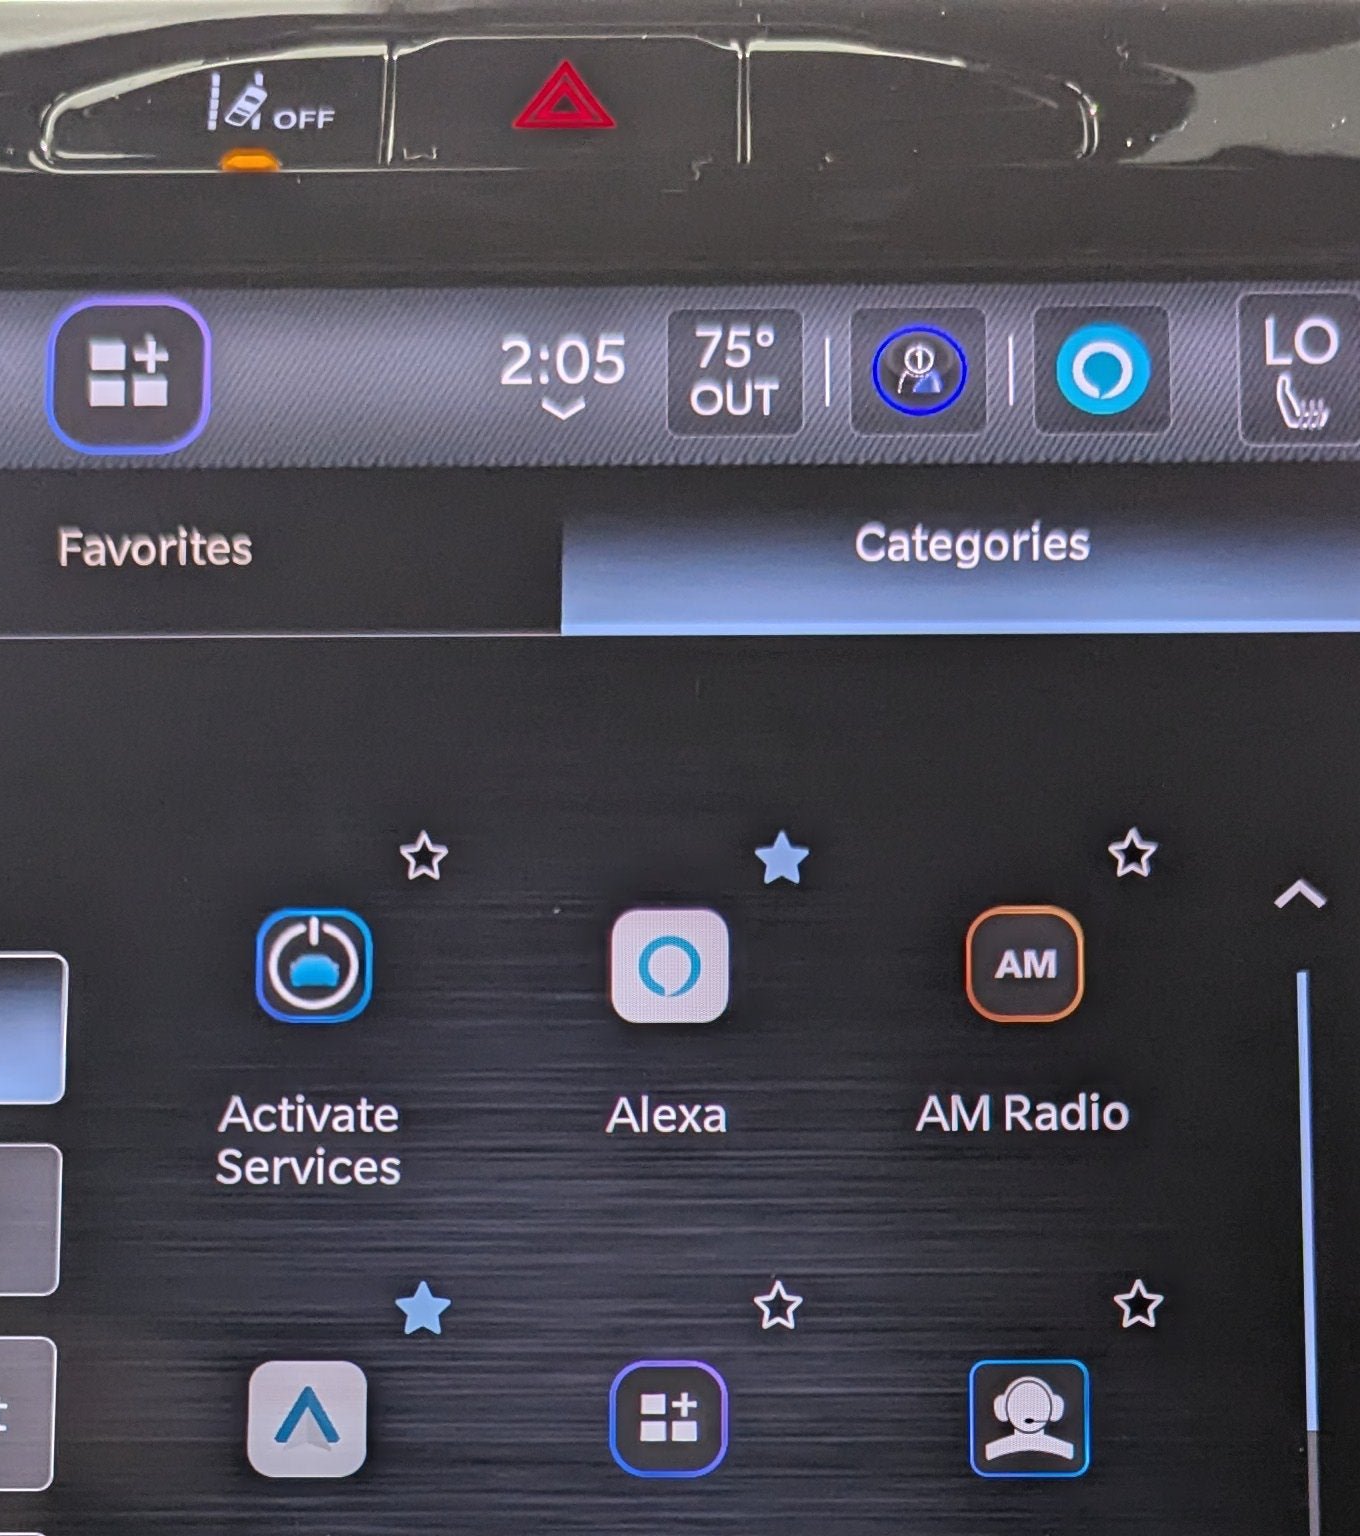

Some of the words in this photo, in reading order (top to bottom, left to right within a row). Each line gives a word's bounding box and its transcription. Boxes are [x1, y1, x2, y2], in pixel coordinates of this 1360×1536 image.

[273, 108, 336, 130] OFF
[501, 334, 625, 385] 2:05
[1265, 316, 1339, 366] LO
[690, 379, 780, 416] OUT
[60, 526, 253, 567] Favorites
[855, 524, 1090, 569] Categories
[994, 949, 1057, 979] AM
[218, 1094, 399, 1133] Activate
[605, 1095, 727, 1133] Alexa
[915, 1094, 990, 1132] AM
[1005, 1092, 1129, 1131] Radio
[216, 1147, 401, 1185] Services
